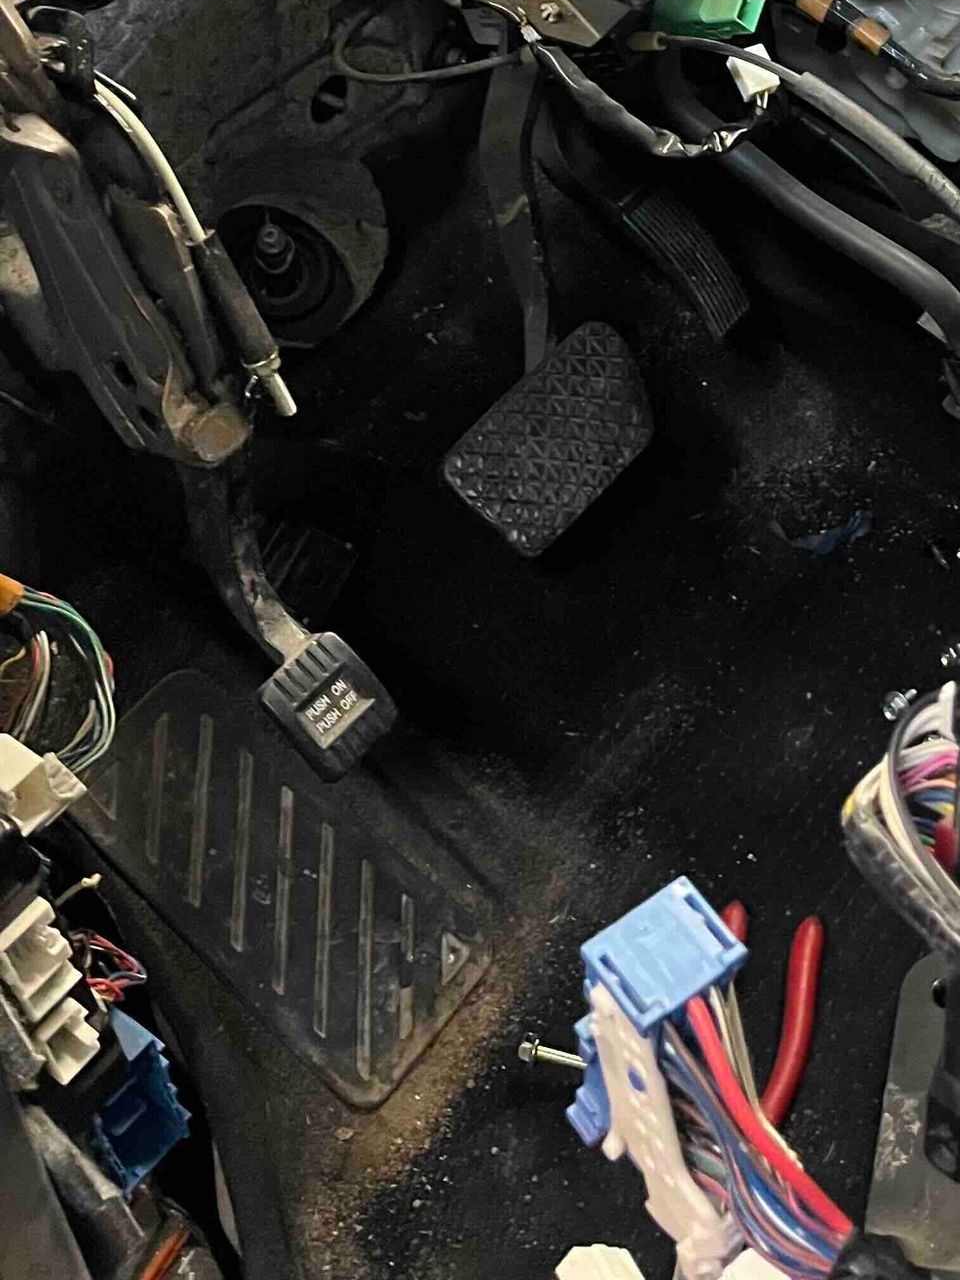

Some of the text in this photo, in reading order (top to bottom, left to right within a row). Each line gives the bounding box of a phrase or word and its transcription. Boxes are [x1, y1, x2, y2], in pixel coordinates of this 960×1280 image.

[305, 679, 347, 721] PUSH ON
[315, 690, 358, 733] PUSH OFF
